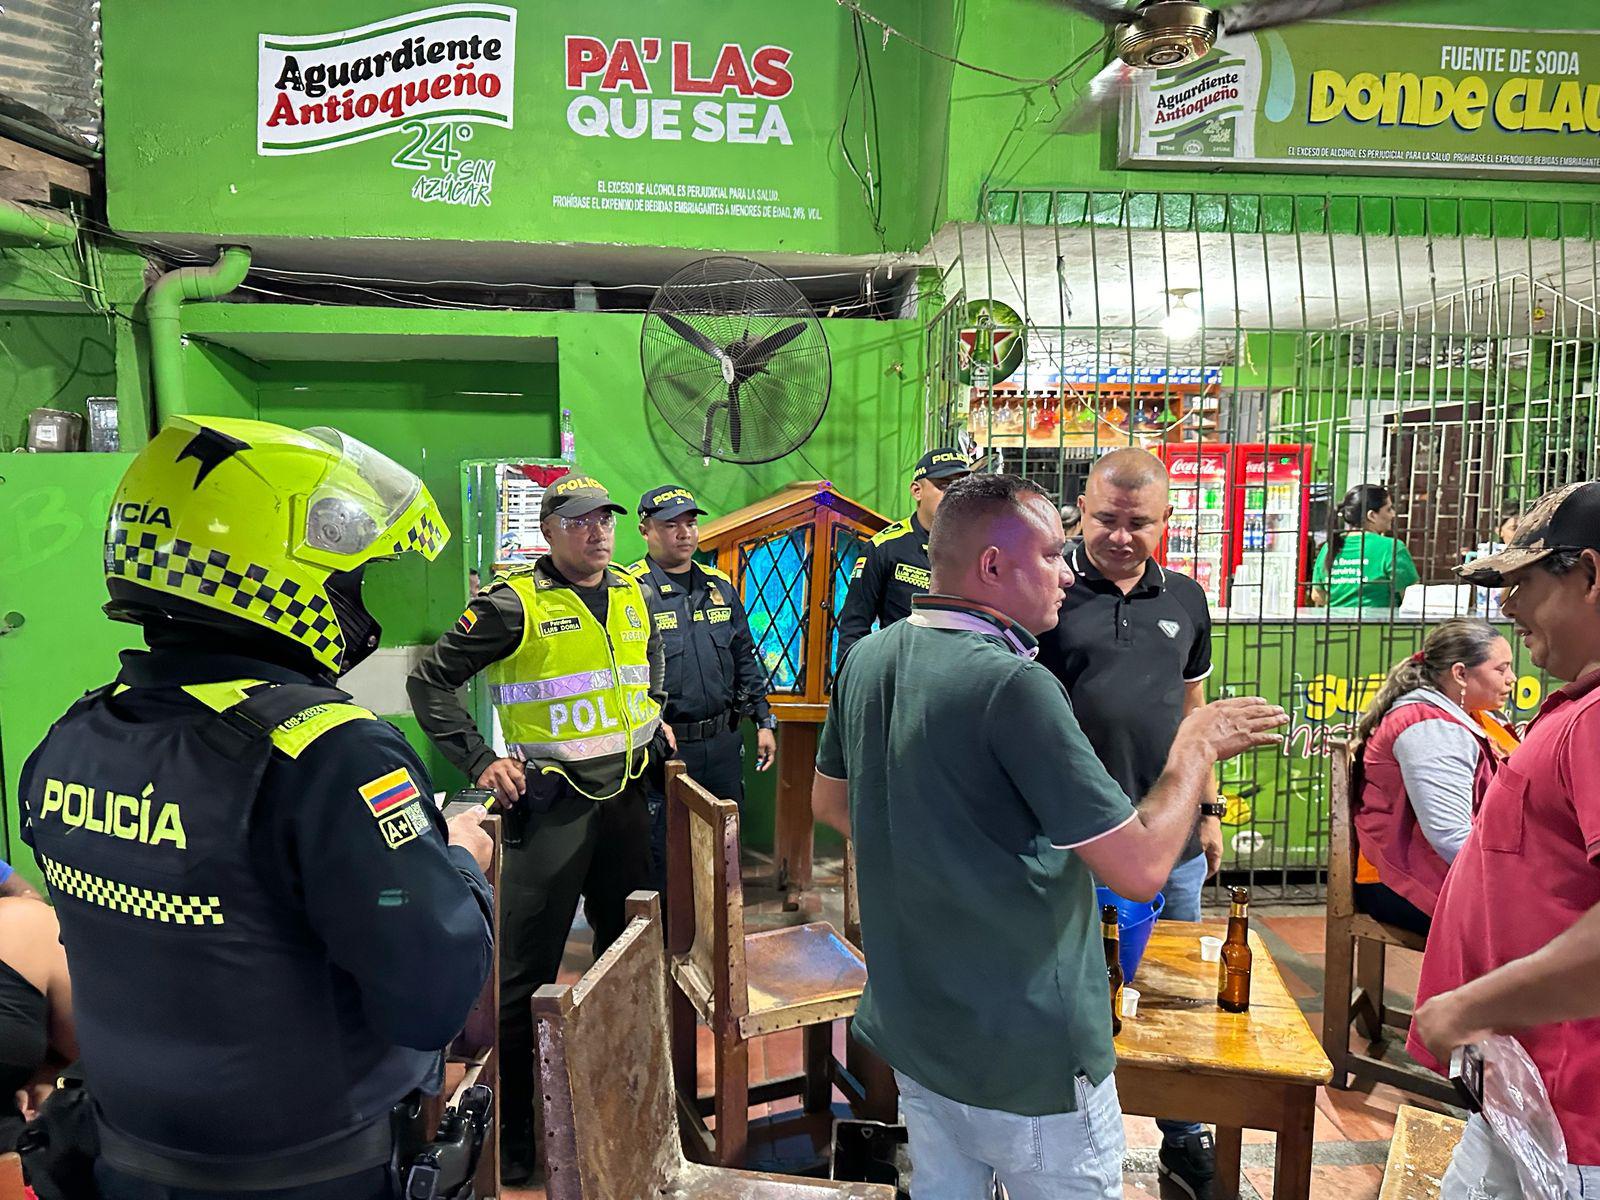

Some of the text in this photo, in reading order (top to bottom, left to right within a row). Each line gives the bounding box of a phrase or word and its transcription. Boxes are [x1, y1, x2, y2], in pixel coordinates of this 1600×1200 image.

[275, 34, 501, 98] Aguardiente
[565, 35, 794, 100] PA' LAS
[1441, 45, 1580, 76] FUENTE DE SODA
[266, 61, 501, 127] Antioqueño
[1154, 86, 1239, 124] Antioqueño
[1157, 72, 1239, 110] Aguardiente
[566, 95, 794, 145] QUE SEA
[457, 159, 496, 184] SIN
[1288, 146, 1295, 156] EL
[1297, 146, 1320, 157] EXCESO
[1322, 147, 1329, 157] DE
[1331, 148, 1357, 158] ALCOHOL
[1359, 149, 1366, 159] ES
[1368, 149, 1404, 160] PERJUDICIAL
[1405, 150, 1421, 161] PARA
[1422, 152, 1430, 161] LA
[1487, 154, 1494, 163] EL
[1496, 154, 1524, 164] EXPENDIO
[1525, 155, 1533, 164] DE
[1534, 156, 1558, 166] BEBIDAS
[411, 172, 492, 207] AZÚCAR
[553, 194, 590, 208] PROHÍBASE
[592, 197, 600, 209] EL
[602, 197, 634, 211] EXPENDIO
[635, 199, 644, 211] DE
[645, 200, 673, 213] BEBIDAS
[674, 201, 724, 216] EMBRIAGANTES
[725, 204, 730, 215] A
[731, 203, 761, 217] MENORES
[763, 205, 772, 218] DE
[598, 180, 605, 193] EL
[608, 181, 634, 194] EXCESO
[635, 182, 644, 195] DE
[646, 183, 675, 196] ALCOHOL
[677, 185, 686, 197] ES
[687, 185, 727, 199] PERJUDICIAL
[729, 187, 746, 200] PARA
[747, 188, 755, 200] LA
[544, 626, 559, 634] LUIS
[40, 778, 187, 850] POLICÍA
[387, 820, 408, 843] A+
